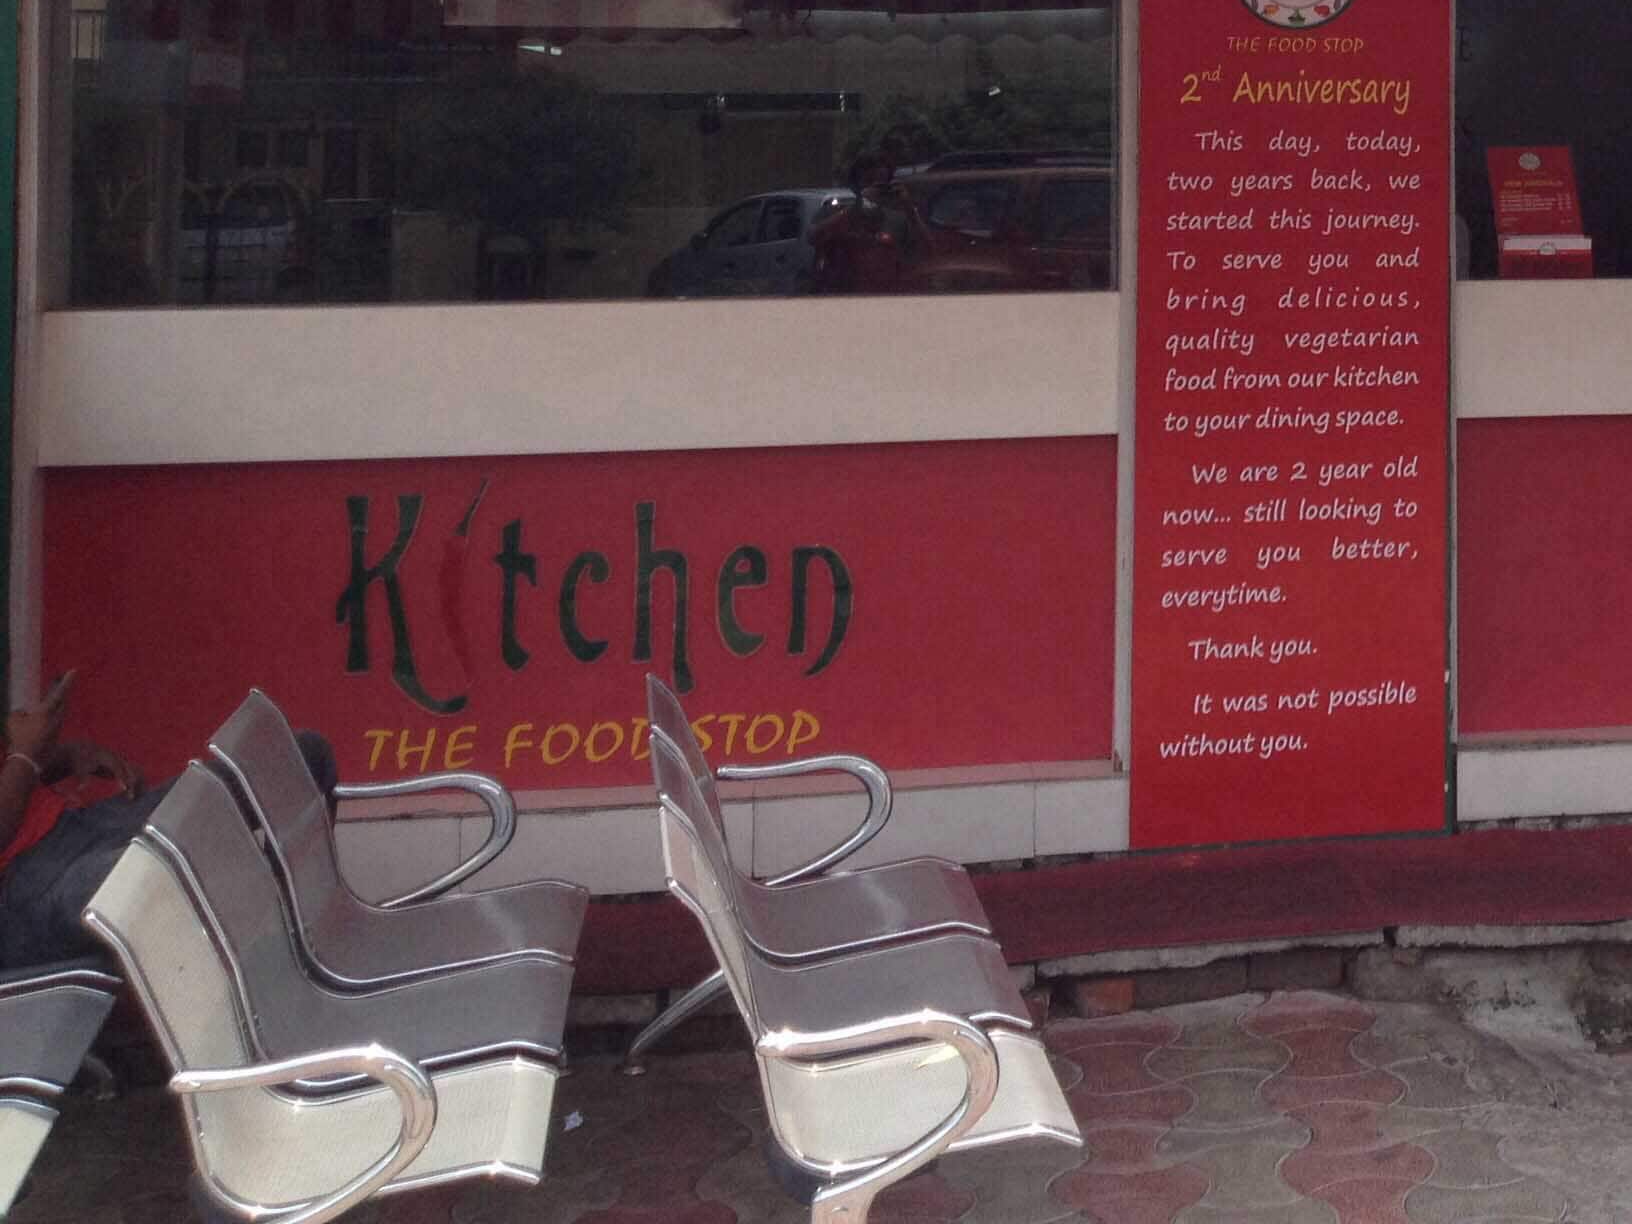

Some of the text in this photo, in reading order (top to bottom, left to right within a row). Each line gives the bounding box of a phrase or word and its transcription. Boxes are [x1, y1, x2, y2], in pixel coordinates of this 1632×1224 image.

[1226, 36, 1365, 53] THE FOOD STOP
[1180, 64, 1412, 114] 2nd Anniversary
[1194, 129, 1421, 158] This day, today,
[1167, 167, 1421, 197] two years back, we
[1166, 207, 1420, 236] started this journey.
[1166, 246, 1420, 276] To serve you and
[1166, 286, 1420, 317] bring delicious,
[1165, 327, 1419, 358] quality vegetarian
[1165, 364, 1420, 392] food from our kitchen
[1164, 406, 1404, 438] to your dining space.
[1191, 455, 1419, 487] We are 2 year old
[1162, 497, 1418, 526] now... still looking to
[1161, 536, 1418, 570] serve you better,
[335, 478, 853, 715] Kitchen
[1161, 580, 1287, 613] everytime.
[1187, 634, 1318, 664] Thank you.
[1193, 679, 1417, 716] It was not possible
[364, 725, 478, 772] THE
[690, 709, 821, 755] STOP
[1159, 732, 1308, 759] without you.
